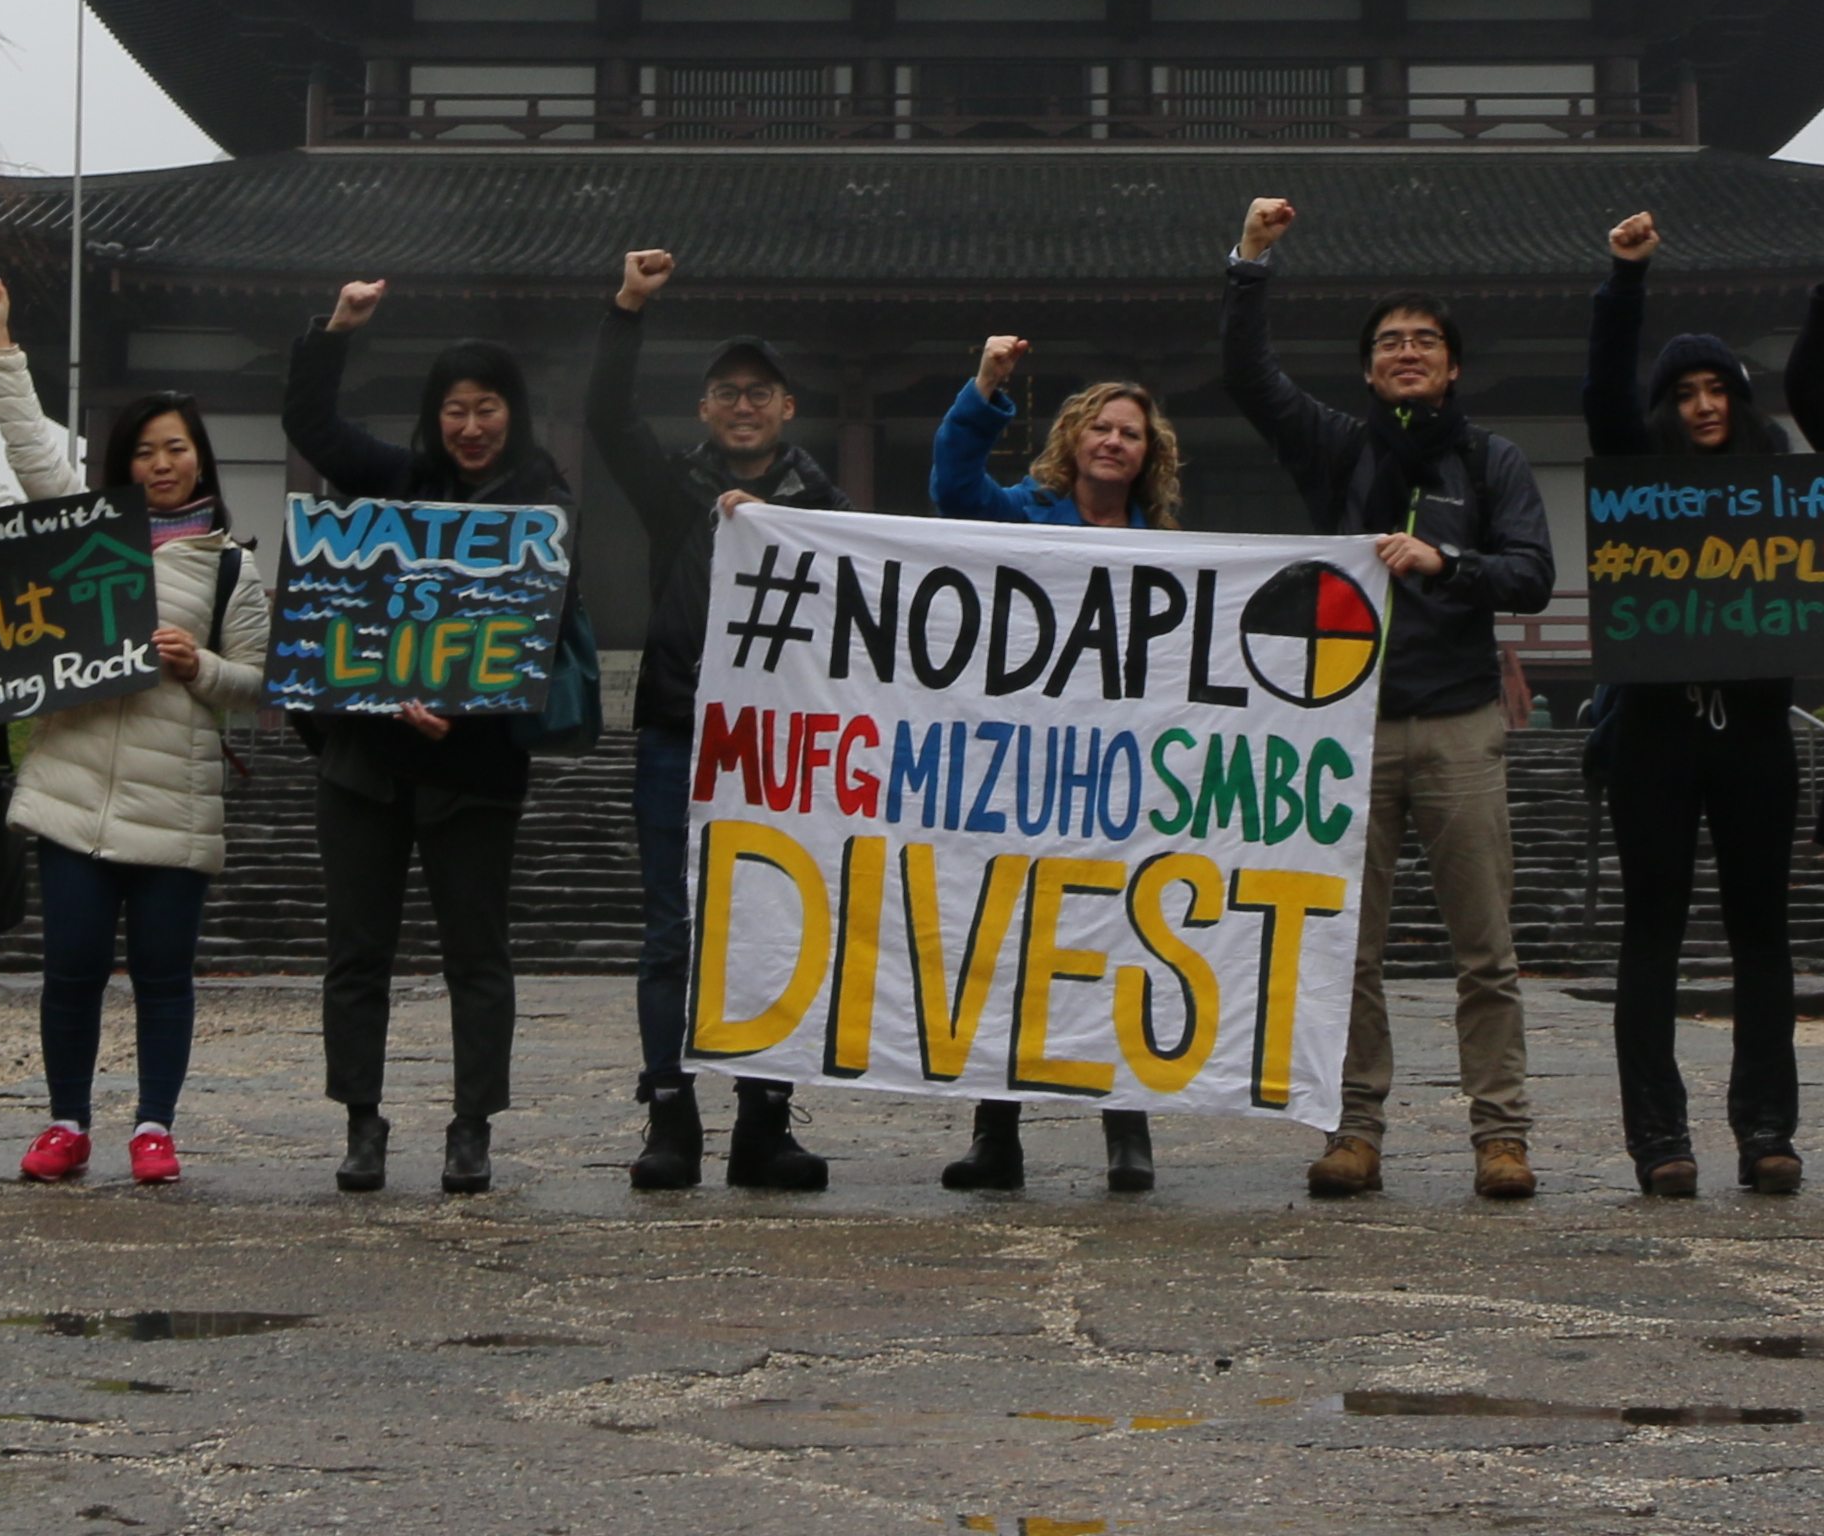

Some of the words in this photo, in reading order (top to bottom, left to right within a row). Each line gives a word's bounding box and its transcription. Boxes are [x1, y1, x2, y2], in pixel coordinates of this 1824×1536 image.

[32, 496, 123, 534] with
[290, 497, 561, 569] WATER
[1728, 485, 1762, 517] is
[326, 615, 535, 692] LIFE
[727, 544, 1250, 708] #NODAPL
[52, 638, 158, 690] Rock
[691, 702, 881, 818] MUFG
[886, 720, 1142, 840] MIZUHO
[1148, 727, 1354, 846] SMBC
[685, 819, 1347, 1110] DIVEST
